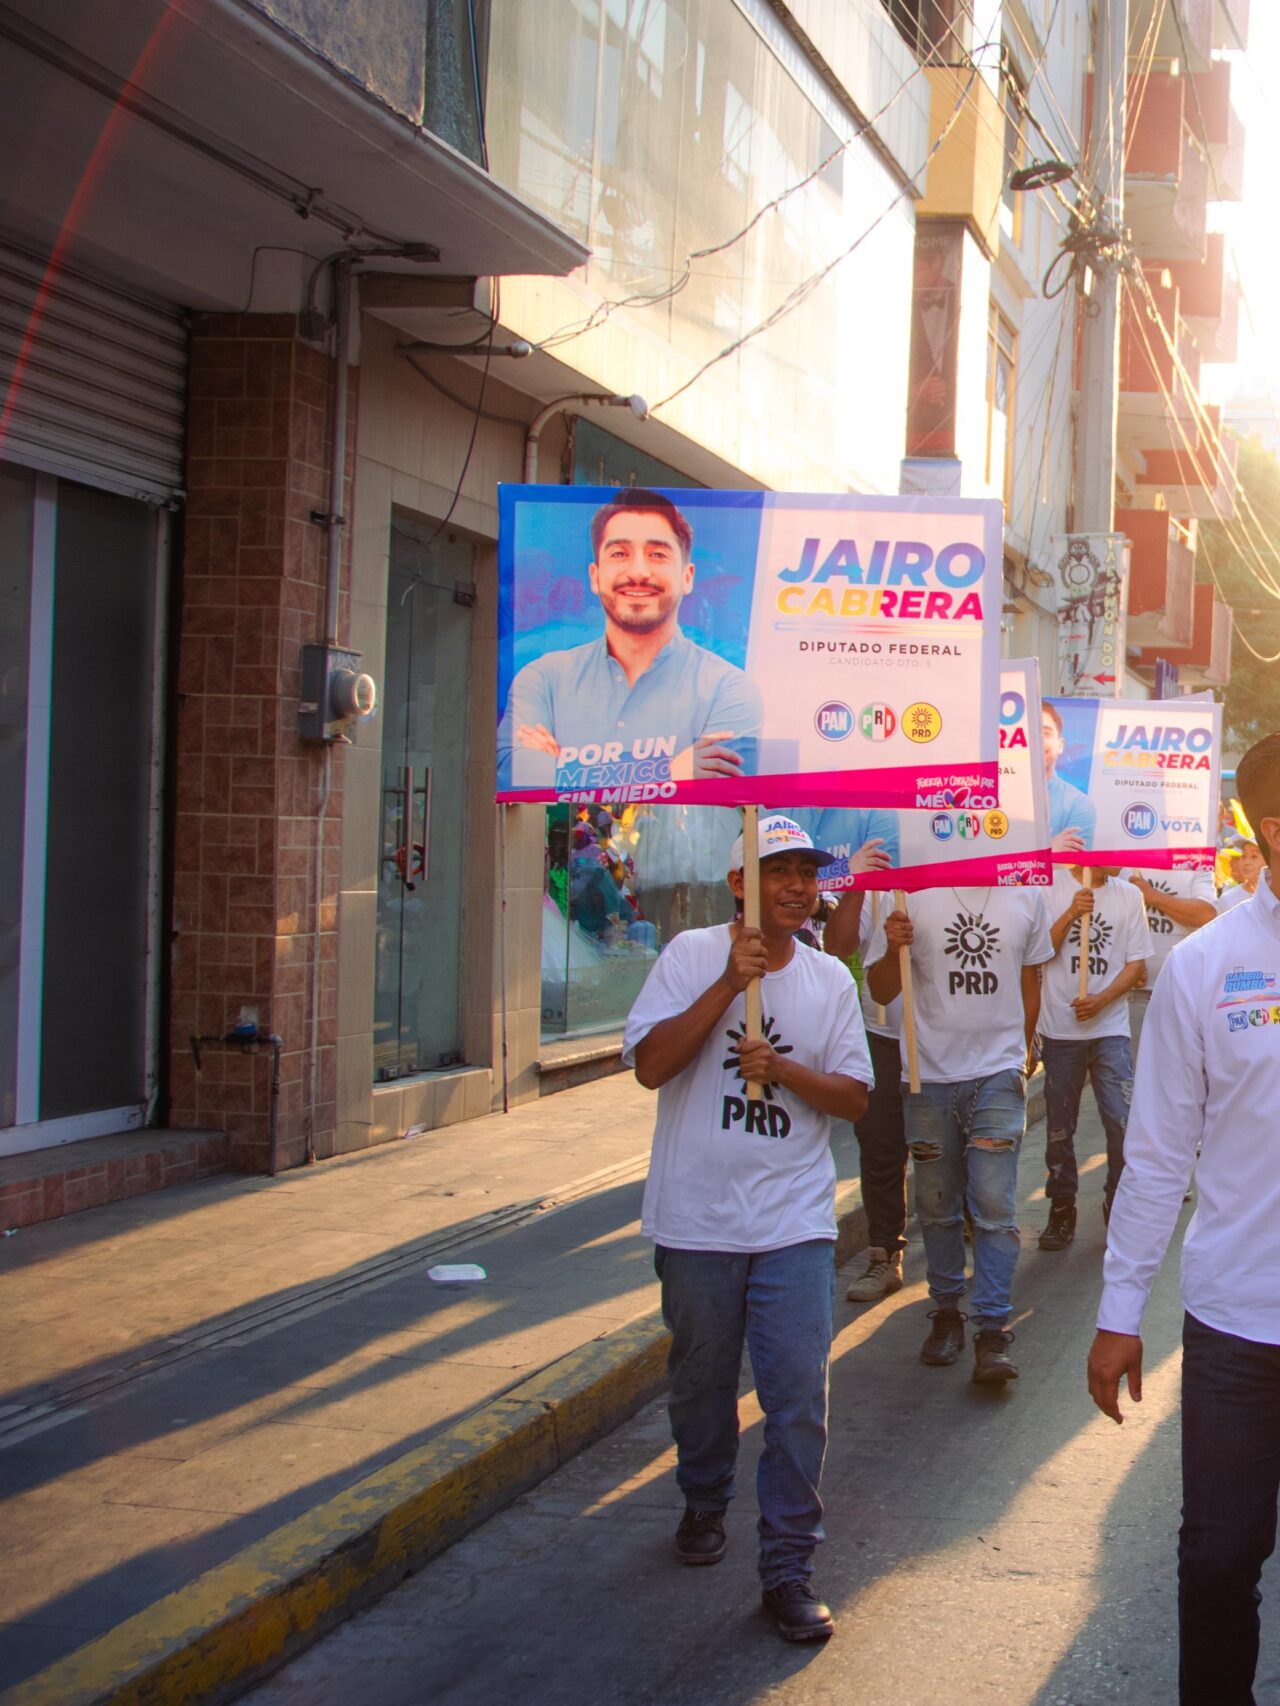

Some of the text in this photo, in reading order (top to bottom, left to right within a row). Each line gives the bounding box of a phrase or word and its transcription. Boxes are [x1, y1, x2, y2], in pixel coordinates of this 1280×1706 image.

[777, 538, 986, 589] JAIRO
[776, 586, 984, 620] CABRERA
[800, 641, 962, 656] DIPUTADO FEDERAL
[829, 657, 894, 667] CANDIDATO
[821, 711, 848, 731] PAN
[862, 710, 892, 731] PRI
[912, 729, 931, 738] PRD
[1105, 725, 1213, 753] JAIRO
[557, 735, 677, 768] POR UN
[1103, 750, 1211, 770] CABRERA
[558, 782, 677, 803] SIN MIEDO
[1115, 779, 1198, 790] DIPUTADO FEDERAL
[934, 820, 951, 833] PAN
[959, 817, 978, 834] PRI
[1128, 811, 1151, 830] PAN
[1161, 820, 1203, 832] VOTA
[1148, 917, 1174, 934] RD
[949, 971, 998, 995] PRD
[722, 1095, 791, 1139] PRD
